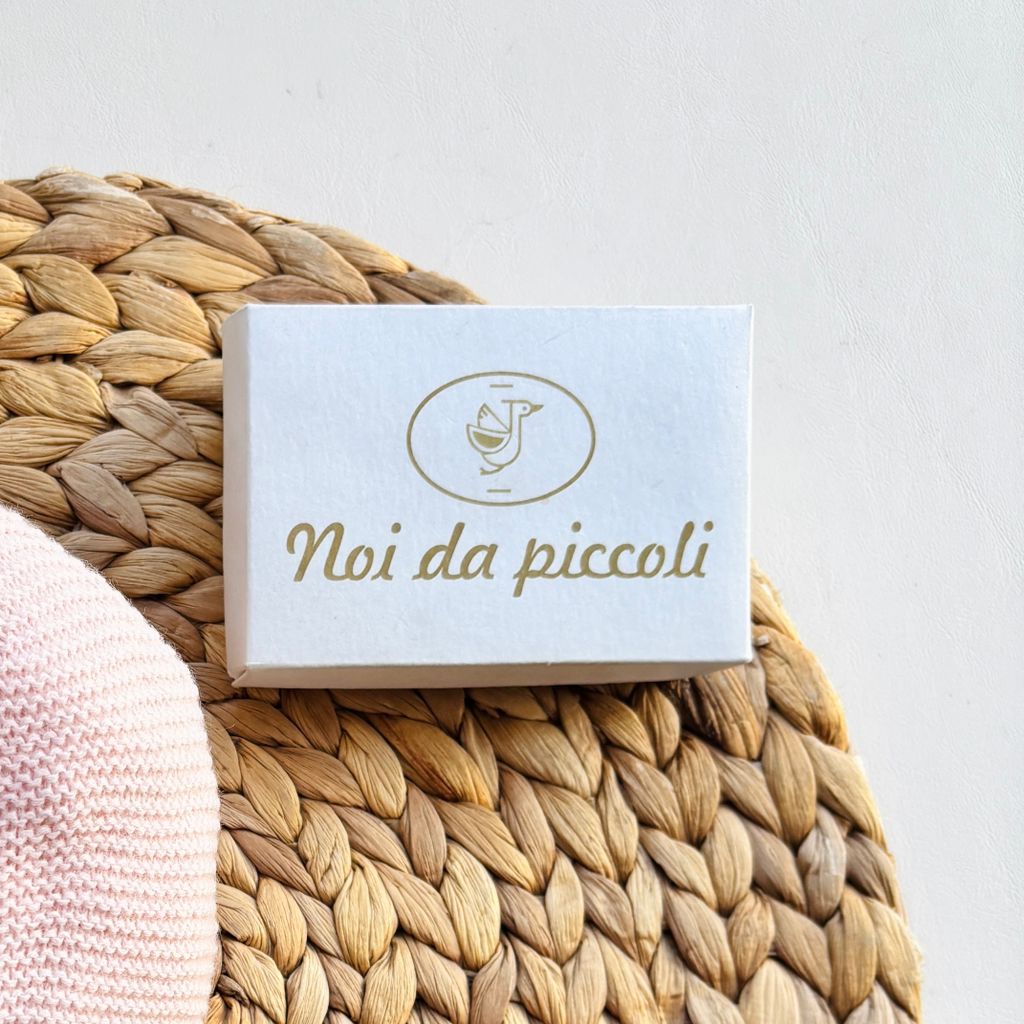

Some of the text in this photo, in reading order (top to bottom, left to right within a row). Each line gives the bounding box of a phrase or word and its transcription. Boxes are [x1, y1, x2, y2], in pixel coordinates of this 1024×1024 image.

[286, 520, 715, 598] Noi da piccoli
